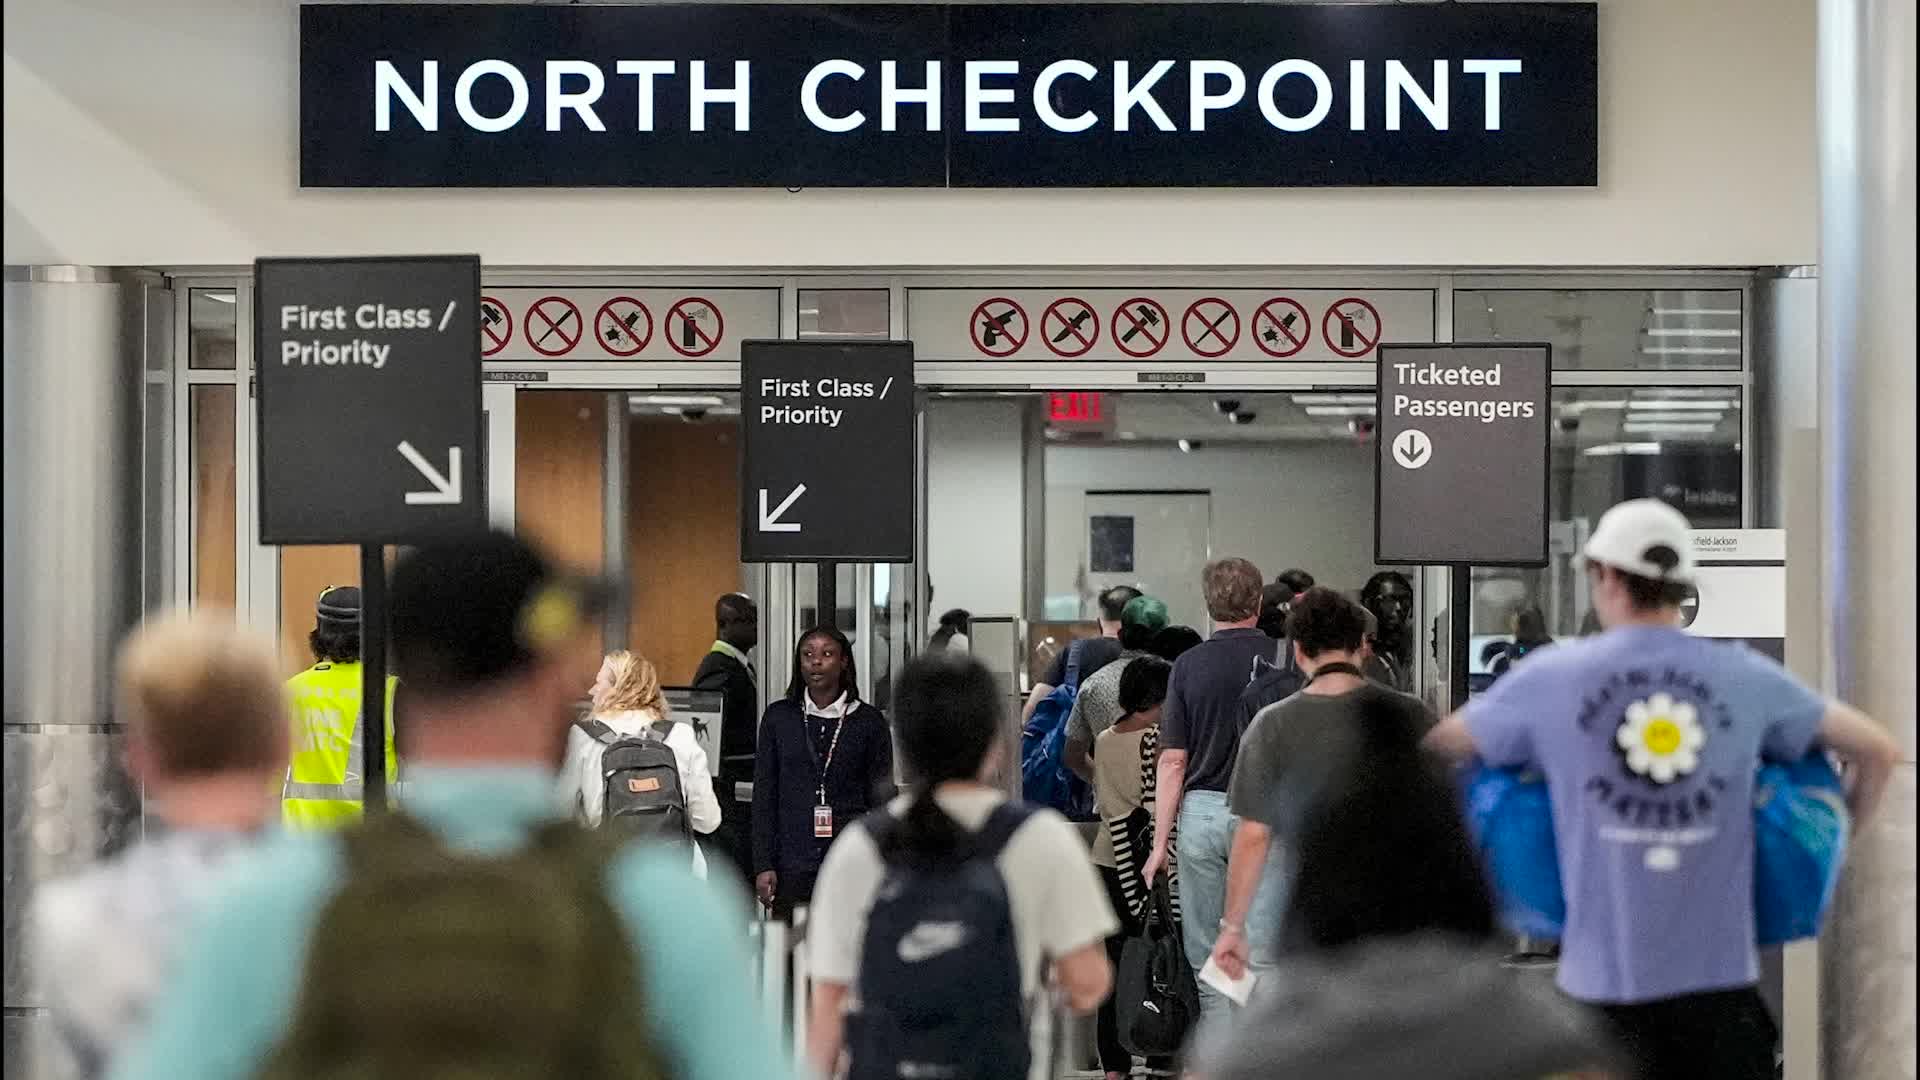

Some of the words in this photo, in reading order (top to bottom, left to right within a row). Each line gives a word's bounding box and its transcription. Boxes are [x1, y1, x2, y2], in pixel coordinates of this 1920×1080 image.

[374, 59, 750, 133] NORTH
[800, 58, 1522, 133] CHECKPOINT
[281, 304, 347, 331] First
[355, 303, 432, 331] Class
[281, 338, 391, 369] Priority
[761, 378, 810, 398] First
[816, 378, 874, 398] Class
[1393, 361, 1501, 387] Ticketed
[761, 404, 843, 428] Priority
[1394, 393, 1535, 424] Passengers
